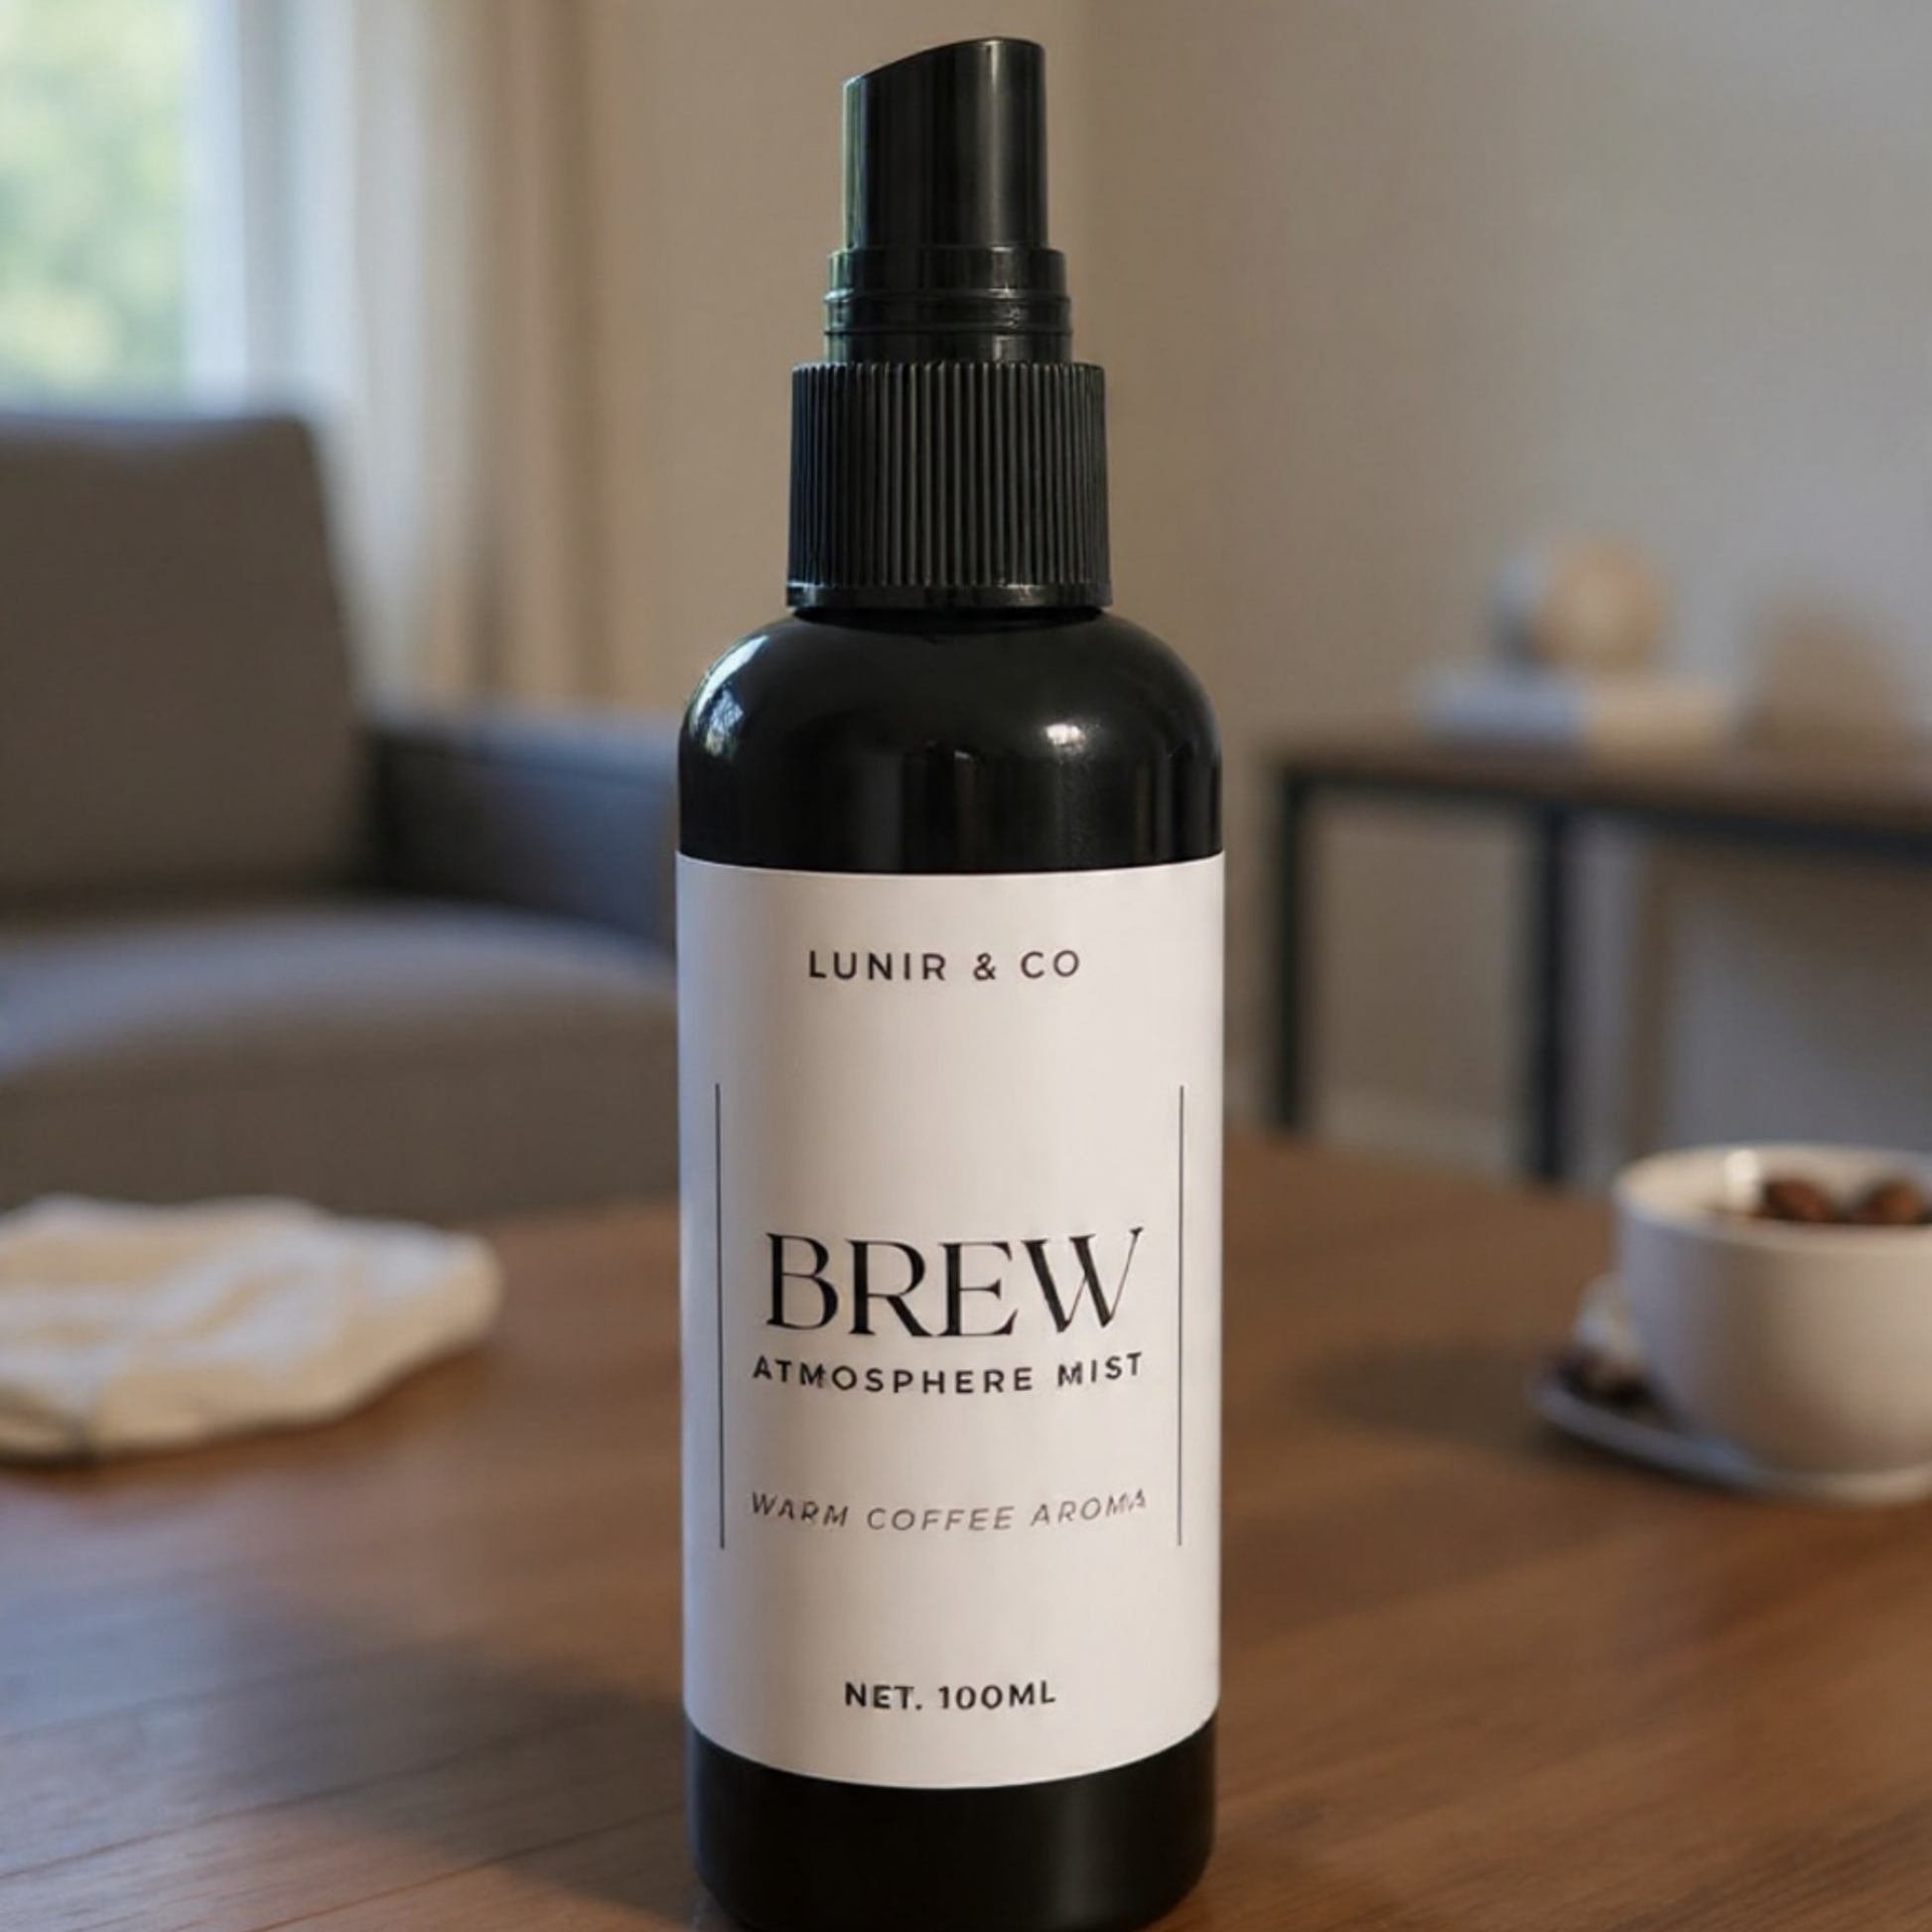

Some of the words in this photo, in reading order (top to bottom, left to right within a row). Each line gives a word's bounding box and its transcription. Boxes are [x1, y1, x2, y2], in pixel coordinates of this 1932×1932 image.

[808, 949, 947, 982] LUNIR
[972, 951, 997, 982] &
[1020, 949, 1080, 980] CO
[765, 1225, 1145, 1339] BREW
[752, 1354, 1034, 1396] ATMOSPHERE
[1056, 1350, 1144, 1388] MIST
[752, 1491, 849, 1528] WARM
[867, 1506, 1015, 1532] COFFEE
[1029, 1488, 1148, 1528] AROMA
[844, 1681, 923, 1712] NET.
[937, 1679, 1057, 1712] 100ML
